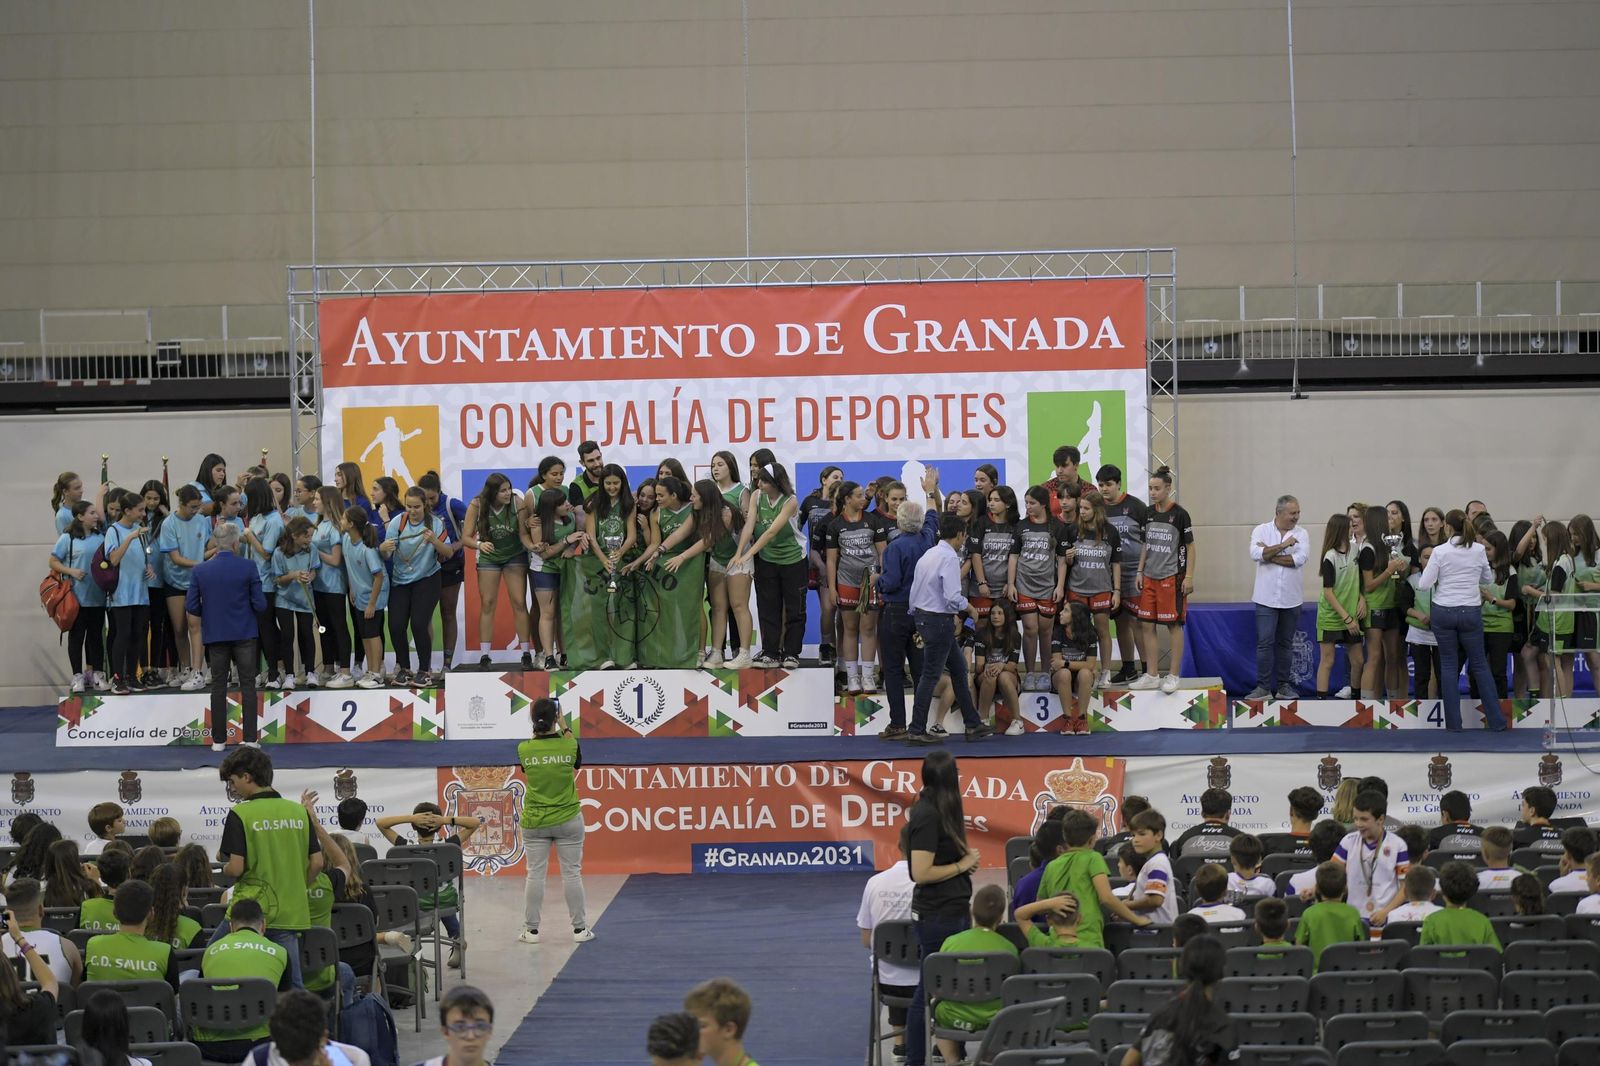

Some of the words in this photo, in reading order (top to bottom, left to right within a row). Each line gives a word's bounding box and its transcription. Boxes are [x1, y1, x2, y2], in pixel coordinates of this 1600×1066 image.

[343, 316, 756, 367] AYUNTAMIENTO
[774, 321, 844, 356] DE
[863, 303, 1125, 355] GRANADA
[460, 386, 710, 449] CONCEJALÍA
[729, 398, 776, 443] DE
[795, 393, 1006, 442] DEPORTES
[632, 683, 643, 719] 1
[1036, 696, 1049, 721] 3
[1427, 701, 1444, 728] 4
[341, 700, 357, 732] 2
[67, 726, 145, 741] Concejalía
[149, 727, 168, 739] de
[809, 765, 850, 788] DE
[862, 760, 1030, 803] GRADA
[790, 803, 826, 829] DE
[705, 845, 862, 868] #GRANADA2031
